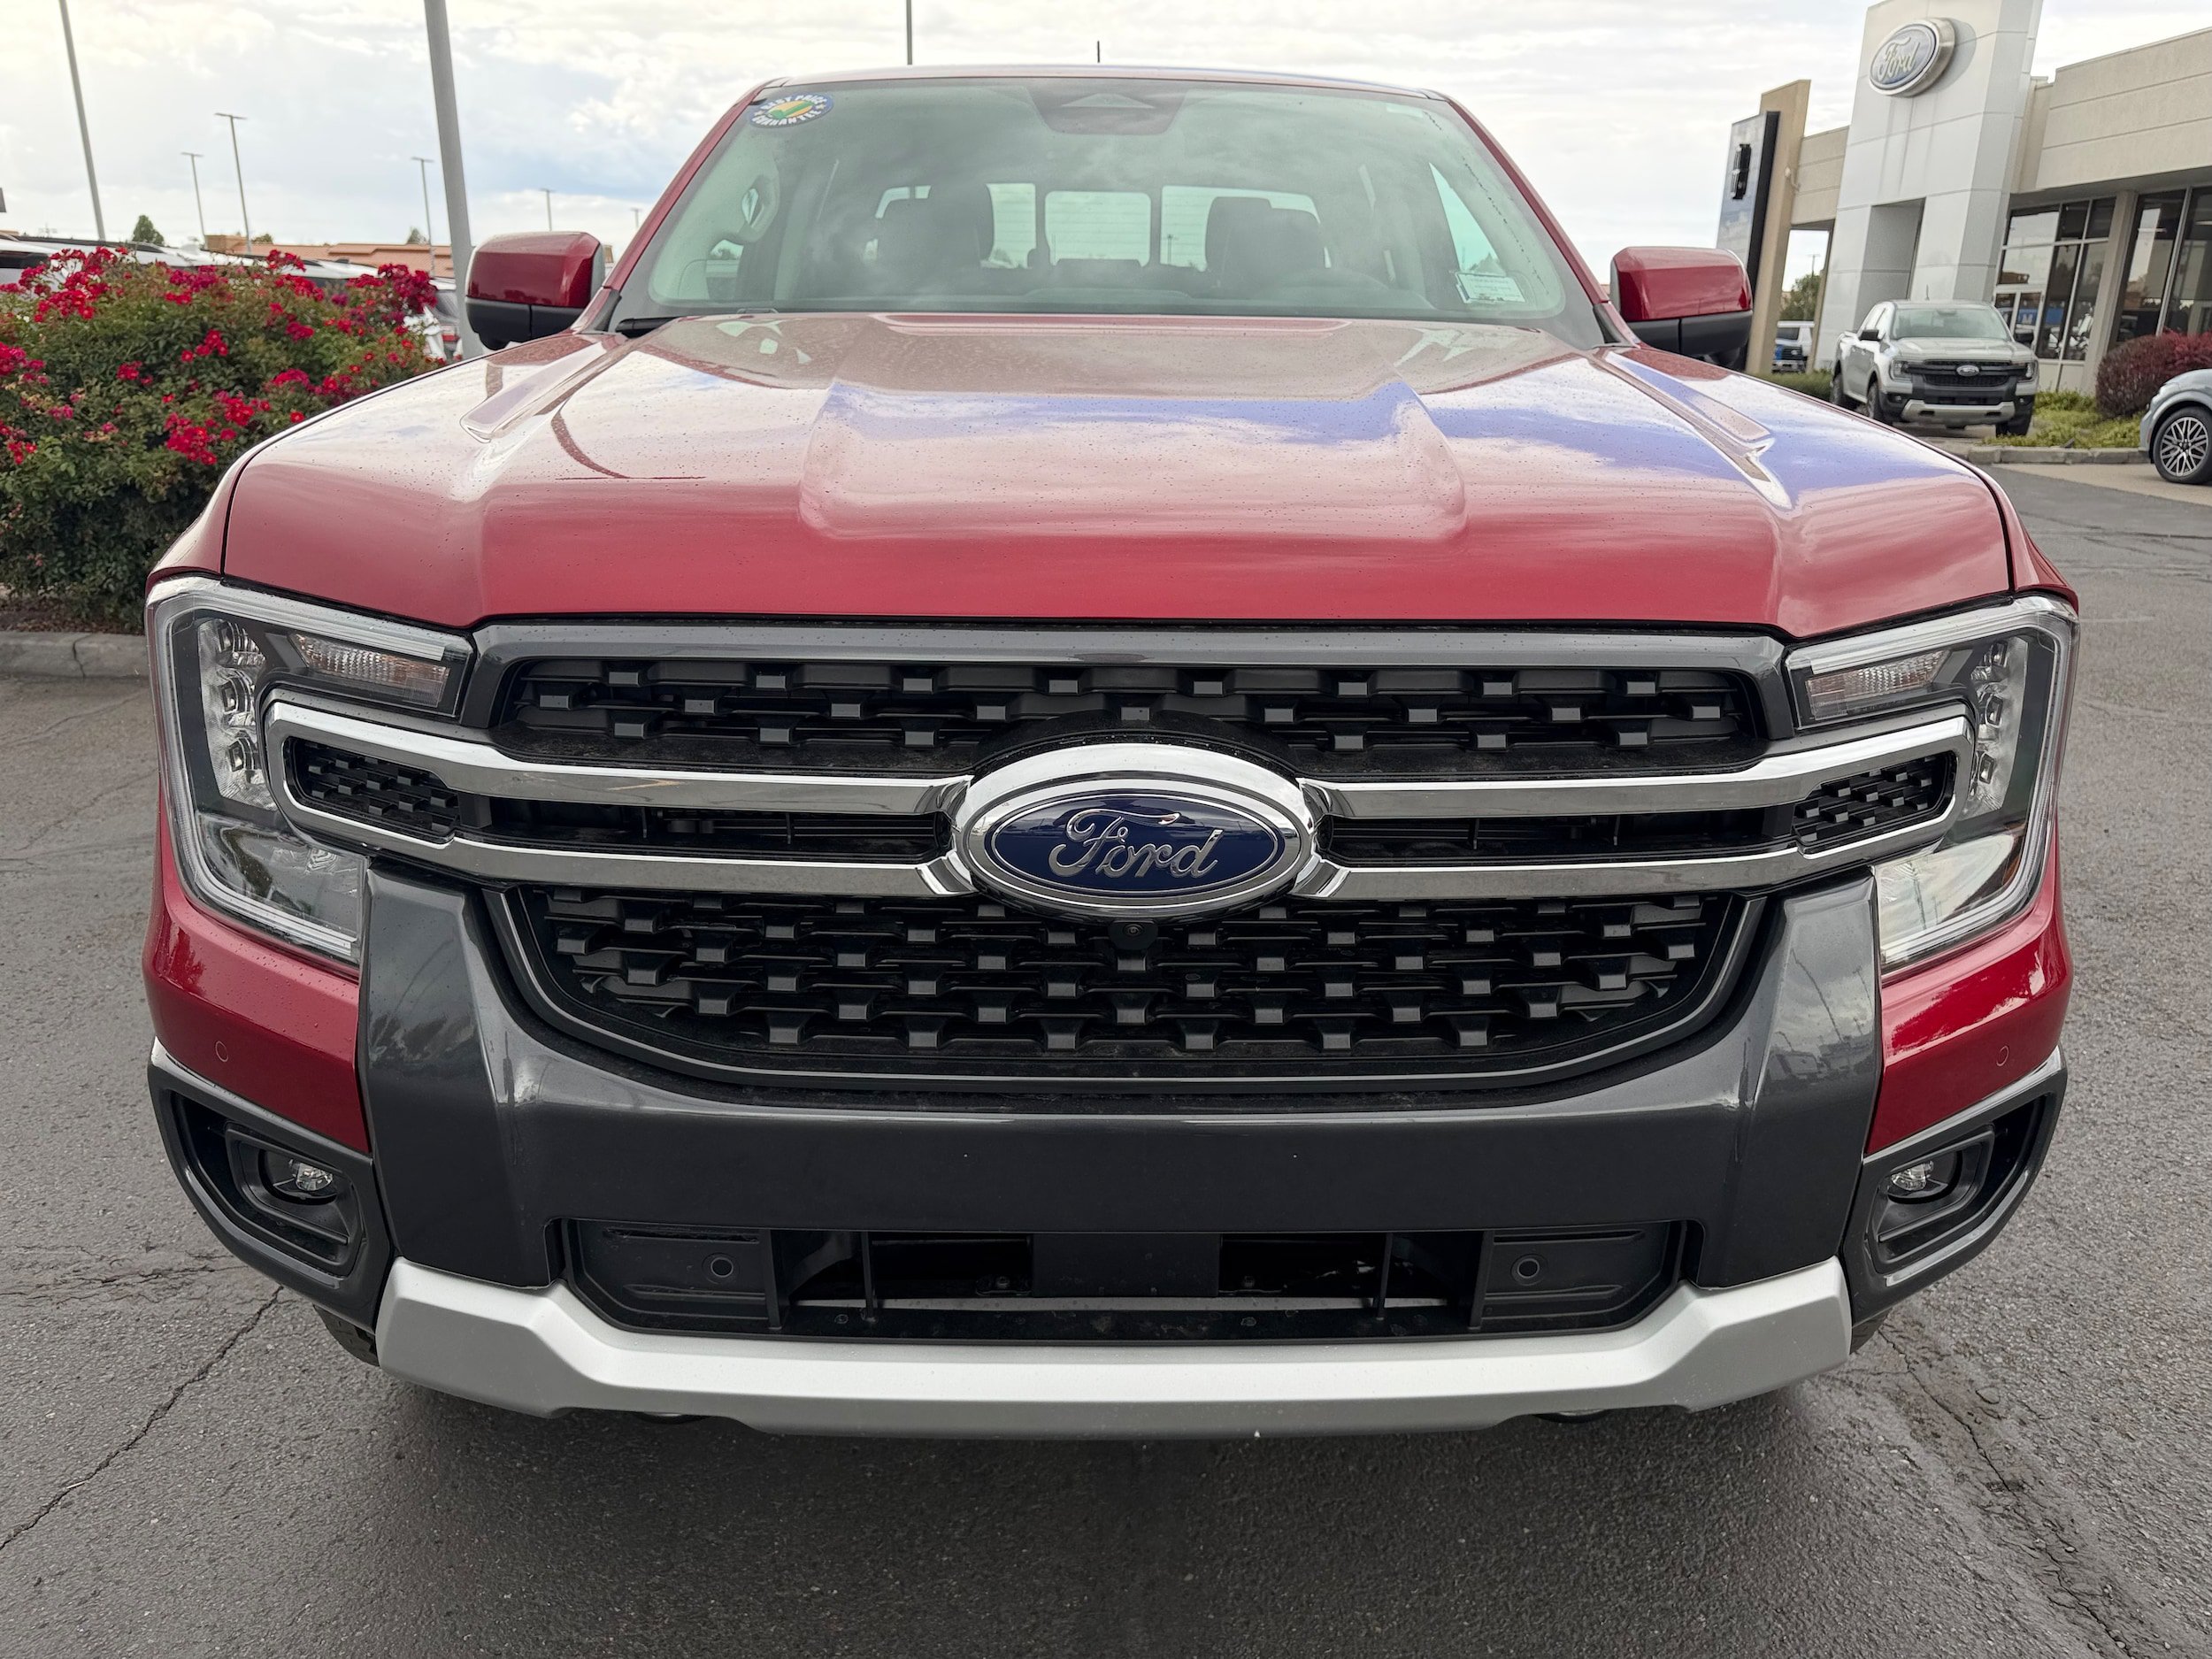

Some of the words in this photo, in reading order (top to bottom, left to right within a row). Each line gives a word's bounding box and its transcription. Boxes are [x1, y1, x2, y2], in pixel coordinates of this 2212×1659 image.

[1877, 36, 1920, 81] Ford
[760, 96, 792, 110] BEST
[795, 94, 827, 105] PRICE
[751, 110, 822, 126] GUARANTEE
[1048, 808, 1224, 879] Ford
